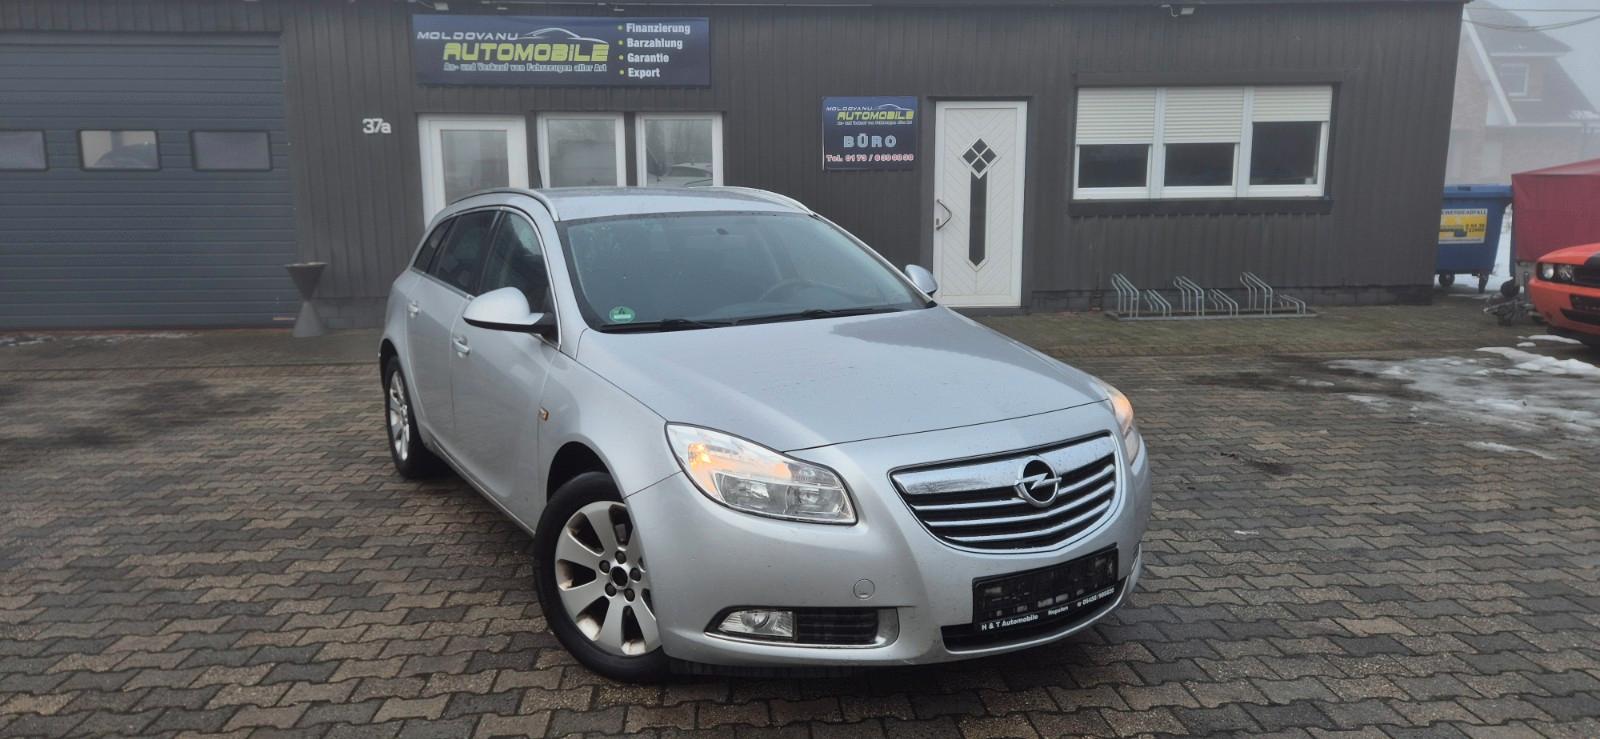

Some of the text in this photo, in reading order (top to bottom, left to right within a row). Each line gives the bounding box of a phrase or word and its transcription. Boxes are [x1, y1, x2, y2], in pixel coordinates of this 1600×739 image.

[416, 31, 519, 41] MOLDOVANU
[625, 22, 691, 36] Finanzierung
[626, 37, 683, 51] Barzahlung
[443, 42, 610, 62] AUTOMOBILE
[627, 52, 670, 64] Garantie
[627, 67, 661, 80] Export
[837, 111, 914, 120] AUTOMOBILE
[362, 118, 391, 134] 37a
[843, 133, 897, 148] BÜRO
[825, 154, 843, 162] Tel.
[988, 622, 995, 630] &
[1002, 614, 1039, 626] Automobile
